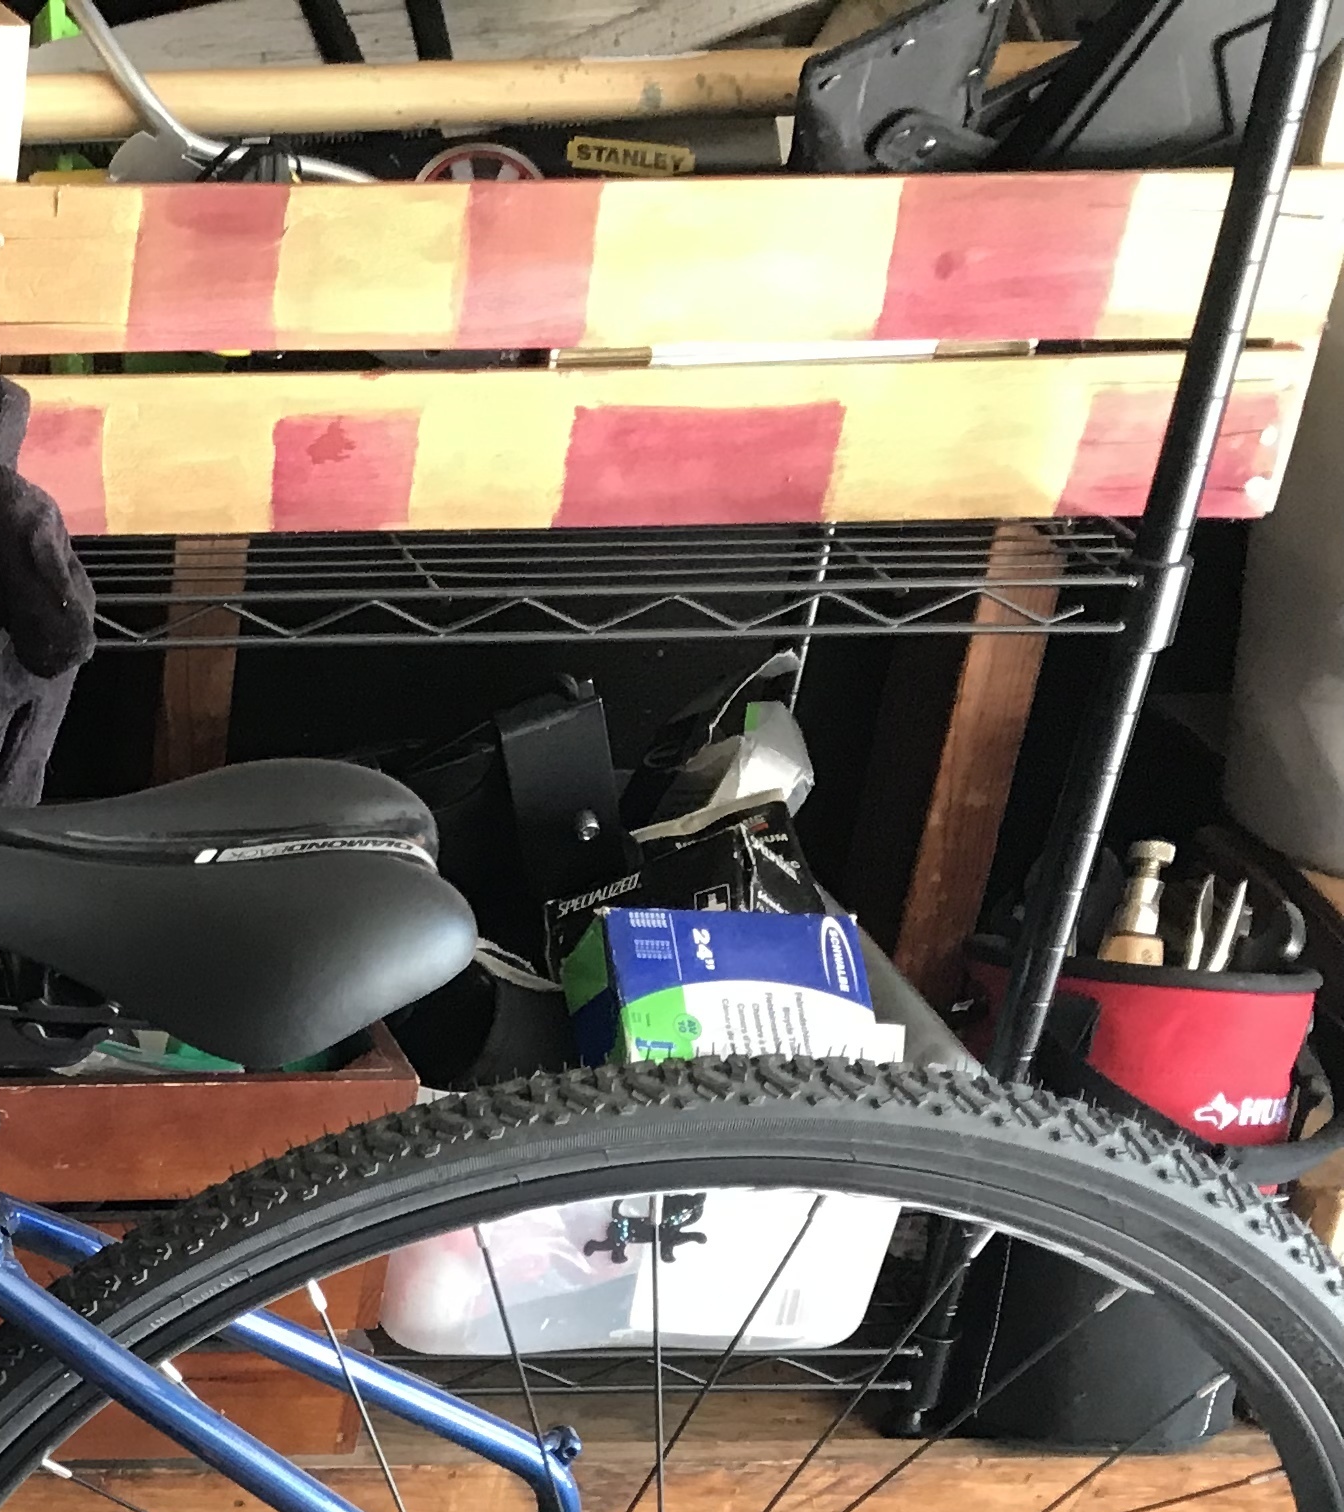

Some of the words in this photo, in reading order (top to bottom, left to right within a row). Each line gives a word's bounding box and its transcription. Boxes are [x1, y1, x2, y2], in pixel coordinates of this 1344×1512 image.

[576, 143, 685, 171] STANLEY
[229, 837, 414, 862] DIAMONDBACK
[557, 871, 642, 919] SPECIALIZED
[827, 926, 851, 993] SCHWALBE
